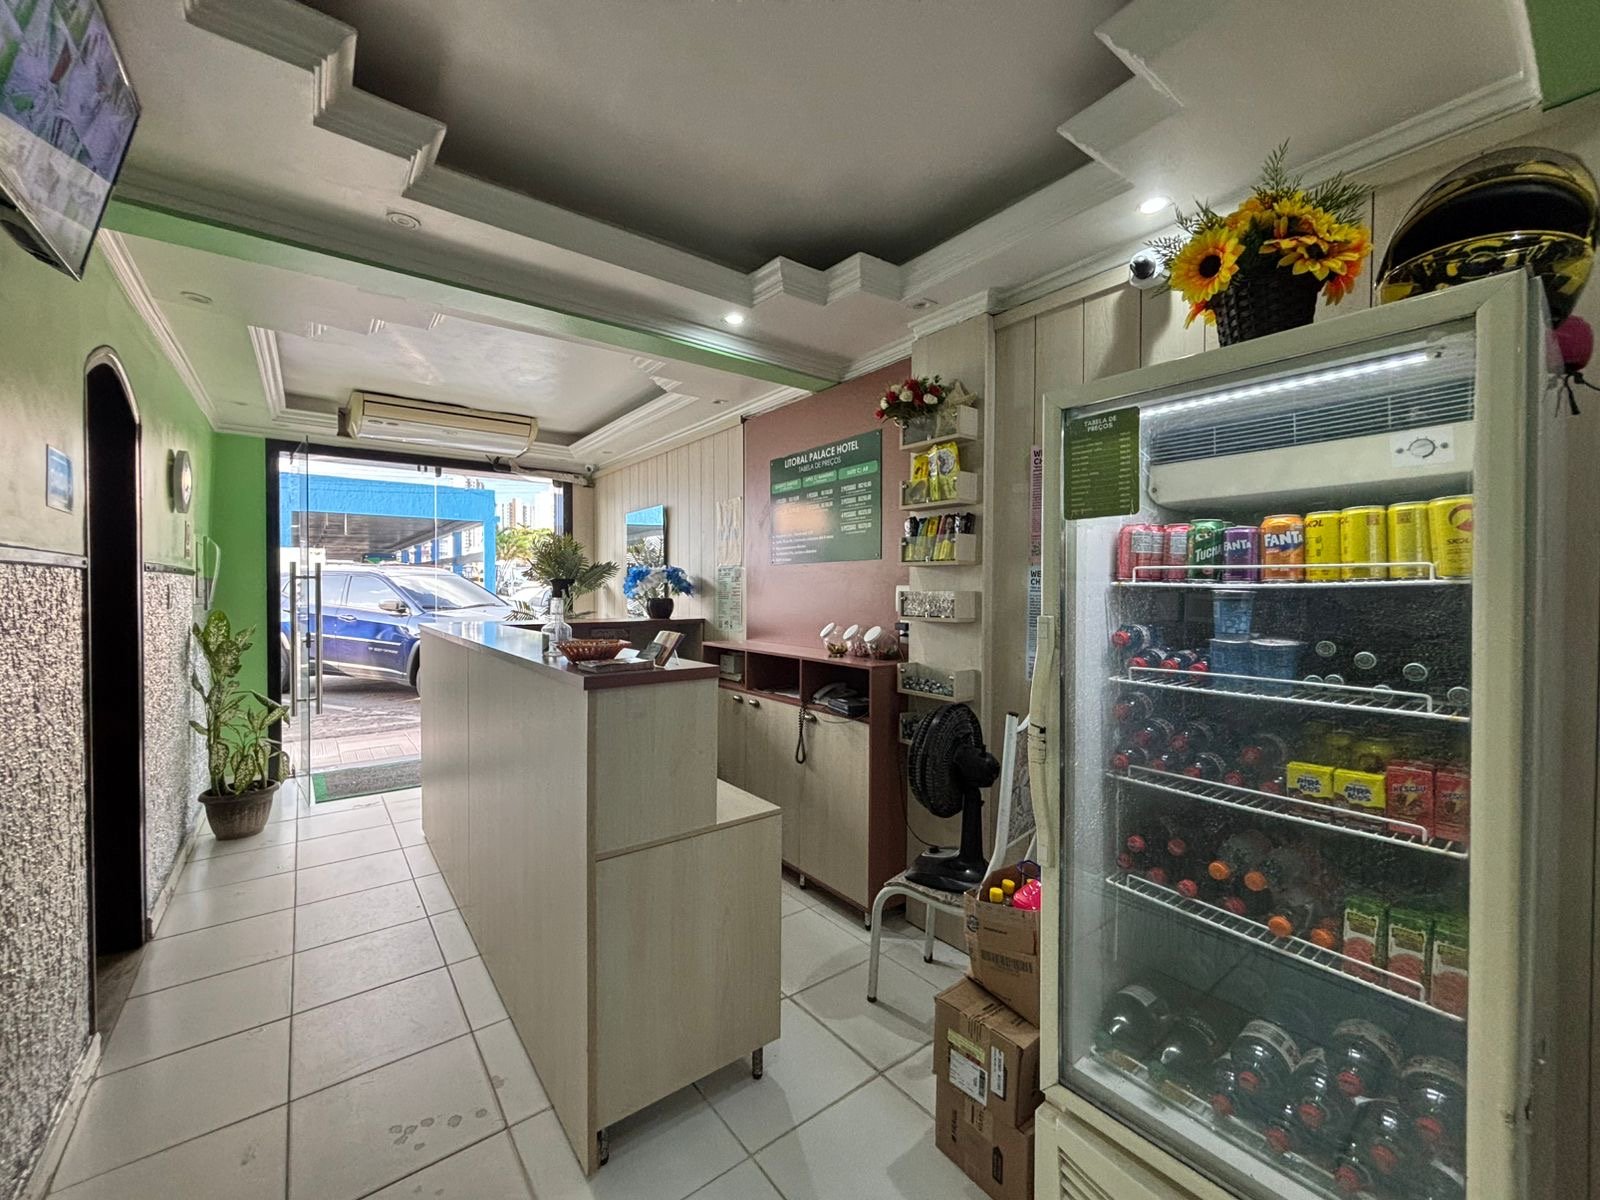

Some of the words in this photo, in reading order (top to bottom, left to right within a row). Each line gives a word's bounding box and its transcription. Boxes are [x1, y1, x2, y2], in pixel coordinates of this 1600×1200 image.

[1084, 417, 1108, 427] TABELA
[1087, 422, 1114, 433] PREÇOS
[784, 454, 808, 469] LITORAL
[809, 446, 836, 462] PALACE
[836, 440, 860, 455] HOTEL
[798, 463, 815, 473] TABELA
[814, 461, 821, 469] DE
[821, 456, 842, 467] PREÇOS
[1223, 539, 1252, 552] FANTA
[1263, 531, 1303, 547] FANTA
